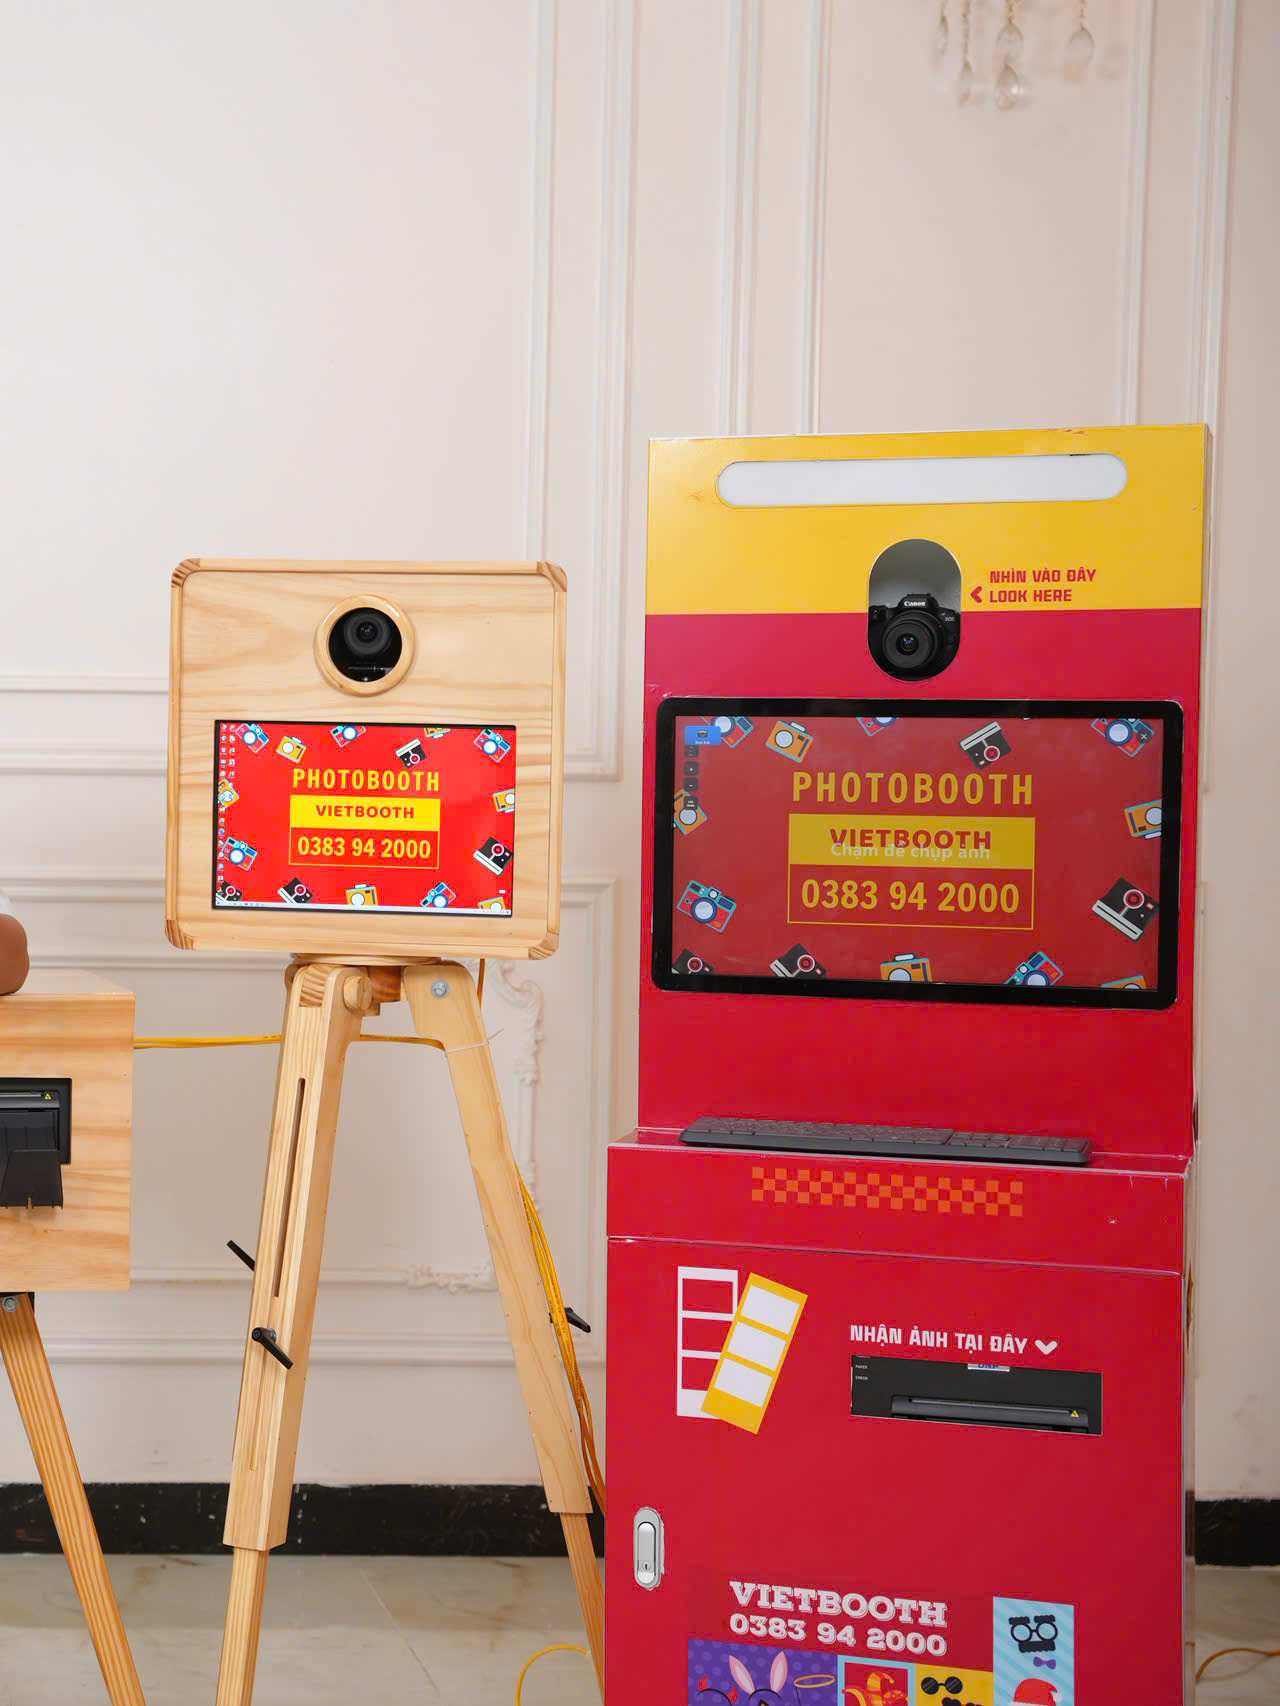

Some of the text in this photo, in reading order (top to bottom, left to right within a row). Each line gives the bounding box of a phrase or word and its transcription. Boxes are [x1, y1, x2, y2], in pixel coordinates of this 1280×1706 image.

[989, 566, 1097, 583] NHÌN VÀO ĐÂY
[989, 589, 1073, 603] LOOK HERE
[292, 768, 440, 792] PHOTOBOOTH
[792, 771, 1033, 805] PHOTOBOOTH
[315, 804, 416, 819] VIETBOOTH
[297, 836, 432, 859] 0383 94 2000
[829, 829, 992, 849] VIETBOOTH
[801, 879, 1020, 913] 0383 94 2000
[850, 1323, 1029, 1354] NHẬN ẢNH TẠI ĐÂY
[728, 1580, 948, 1628] VIETBOOTH
[729, 1613, 948, 1657] 0383 94 2000
